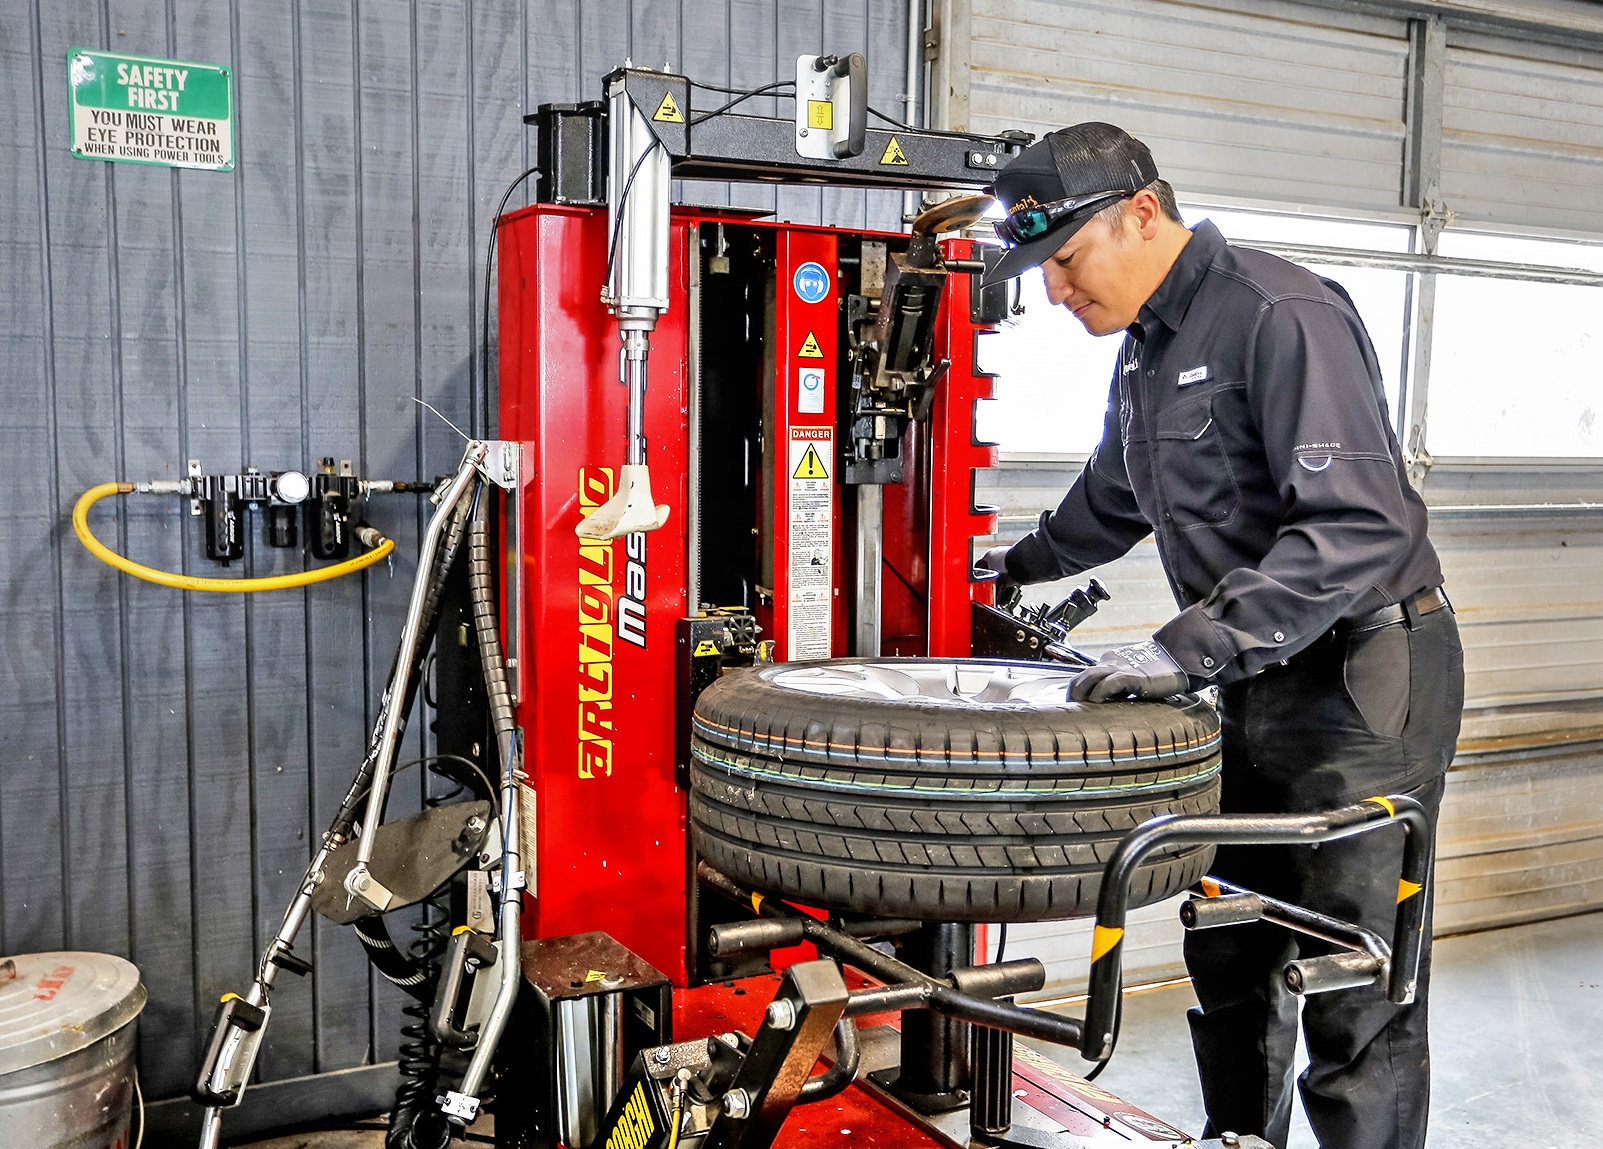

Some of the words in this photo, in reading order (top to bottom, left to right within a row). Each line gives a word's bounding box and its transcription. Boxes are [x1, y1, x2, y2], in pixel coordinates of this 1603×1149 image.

[117, 63, 188, 91] SAFETY
[128, 87, 180, 111] FIRST
[91, 110, 121, 126] YOU
[126, 113, 164, 132] MUST
[171, 118, 216, 135] WEAR
[88, 127, 117, 144] EYE
[125, 131, 220, 153] PROTECTION
[84, 142, 115, 155] WHEN
[119, 146, 150, 158] USING
[154, 150, 189, 162] POWER
[194, 153, 224, 165] TOOLS
[792, 430, 830, 438] DANGER
